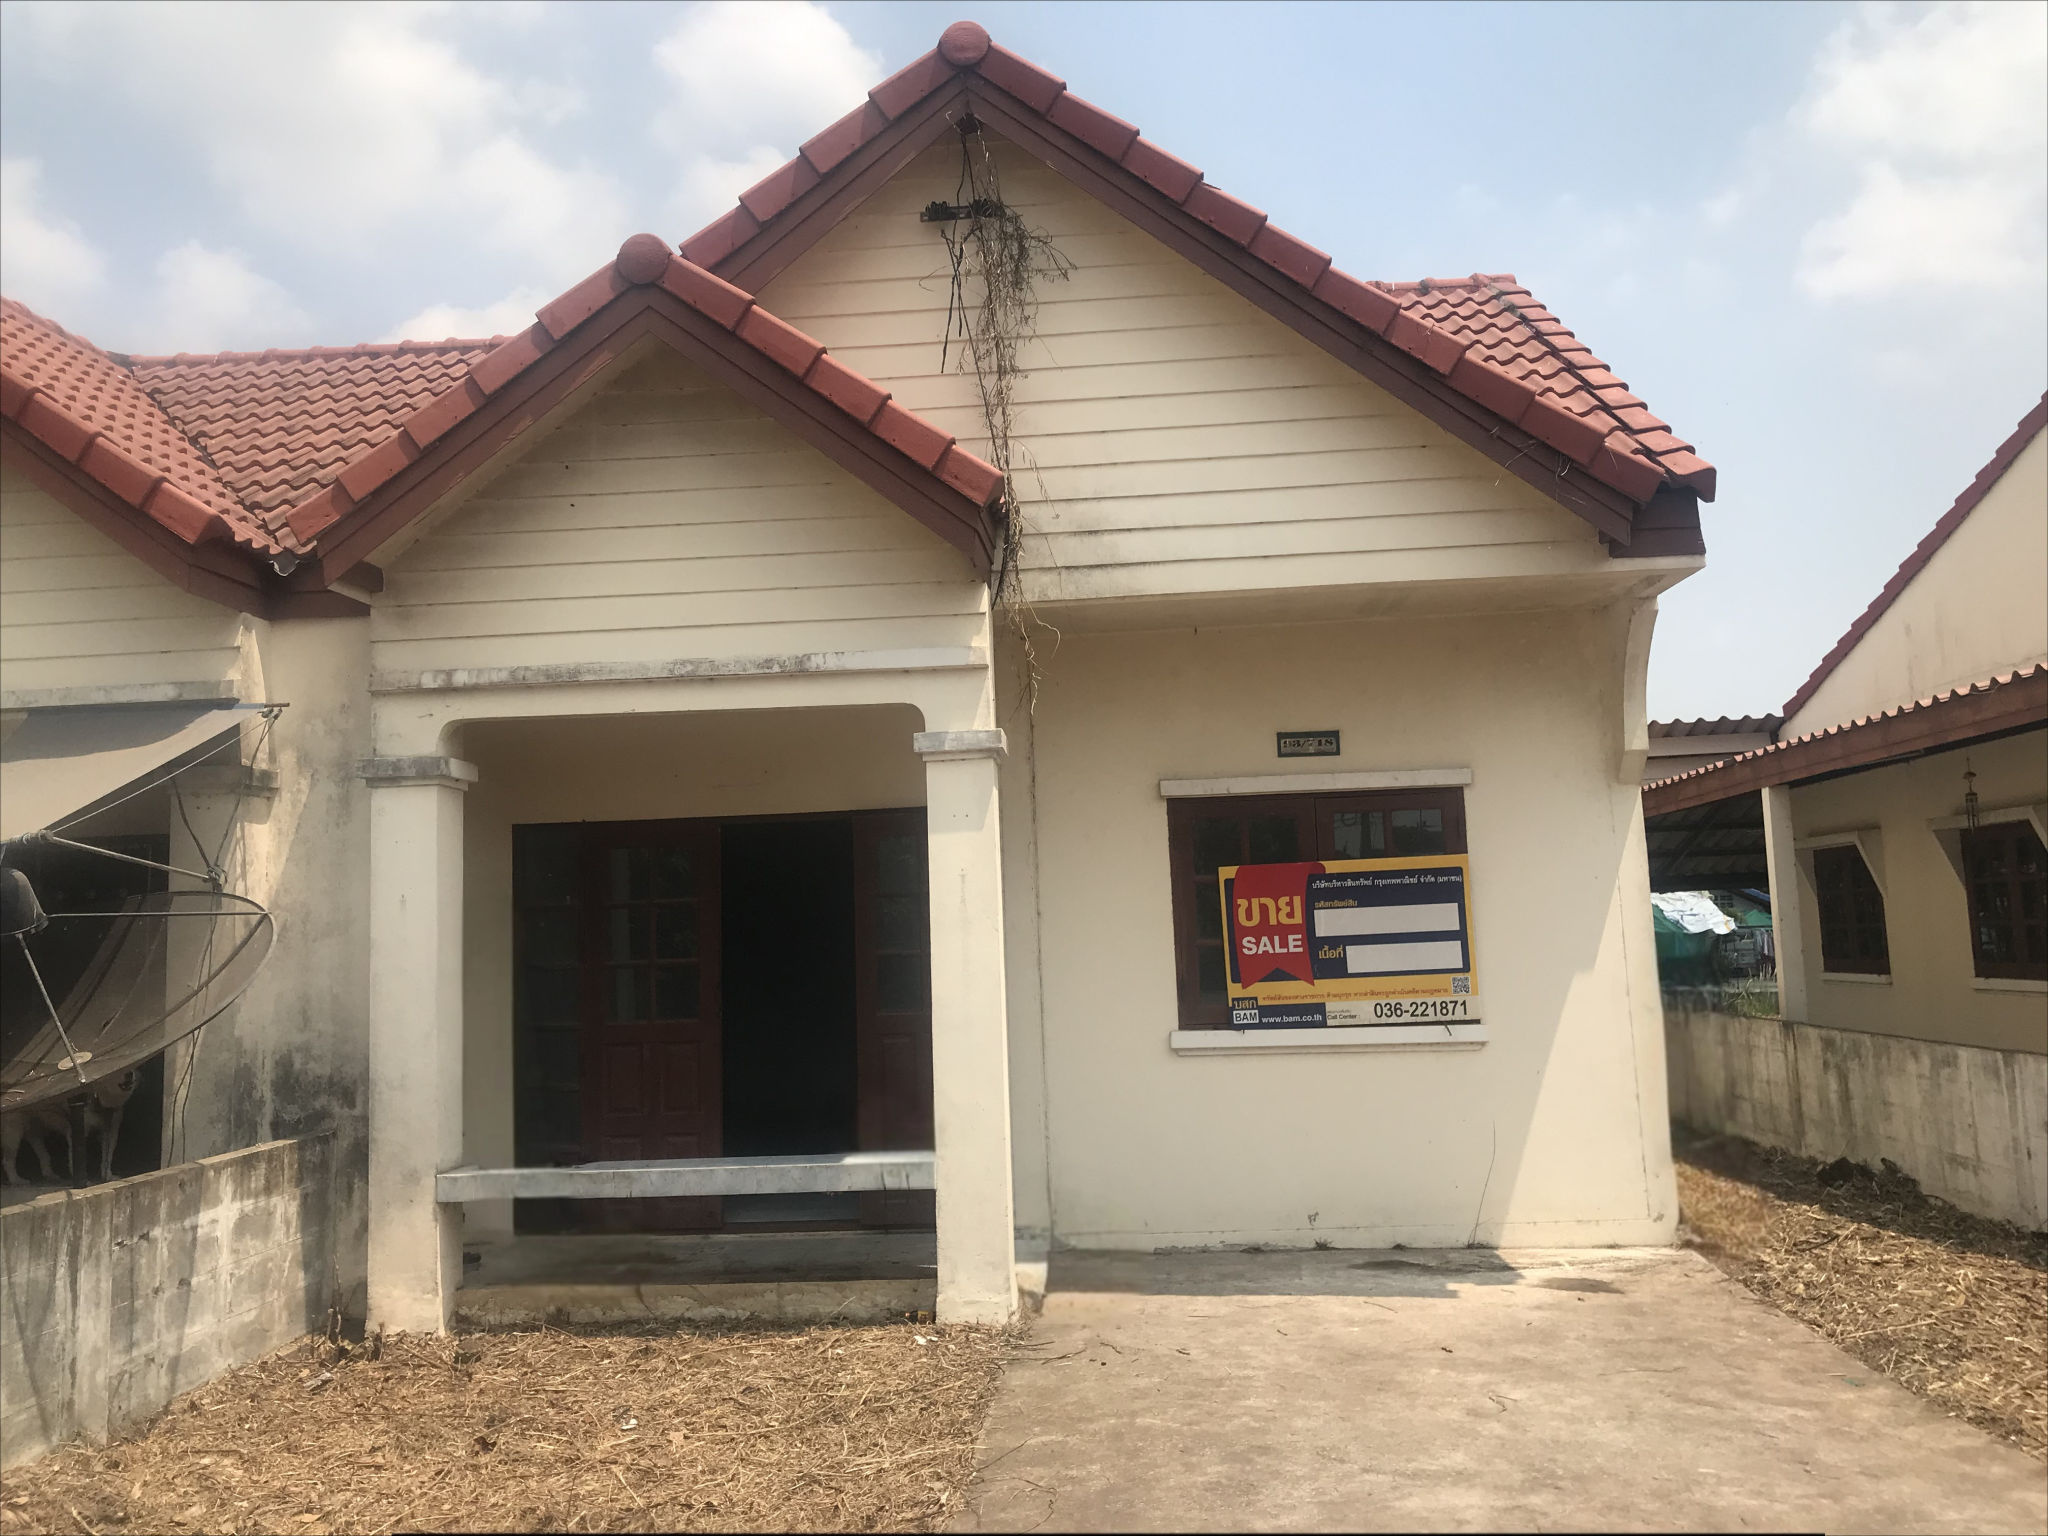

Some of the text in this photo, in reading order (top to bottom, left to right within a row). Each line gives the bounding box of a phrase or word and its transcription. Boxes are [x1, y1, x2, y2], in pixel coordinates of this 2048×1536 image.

[1237, 895, 1302, 927] ขาย
[1242, 934, 1303, 955] SALE
[1319, 945, 1344, 959] เนื้อที่
[1235, 1011, 1258, 1022] BAM
[1374, 1000, 1468, 1018] 036-221871
[1261, 1013, 1322, 1024] www.bam.co.th
